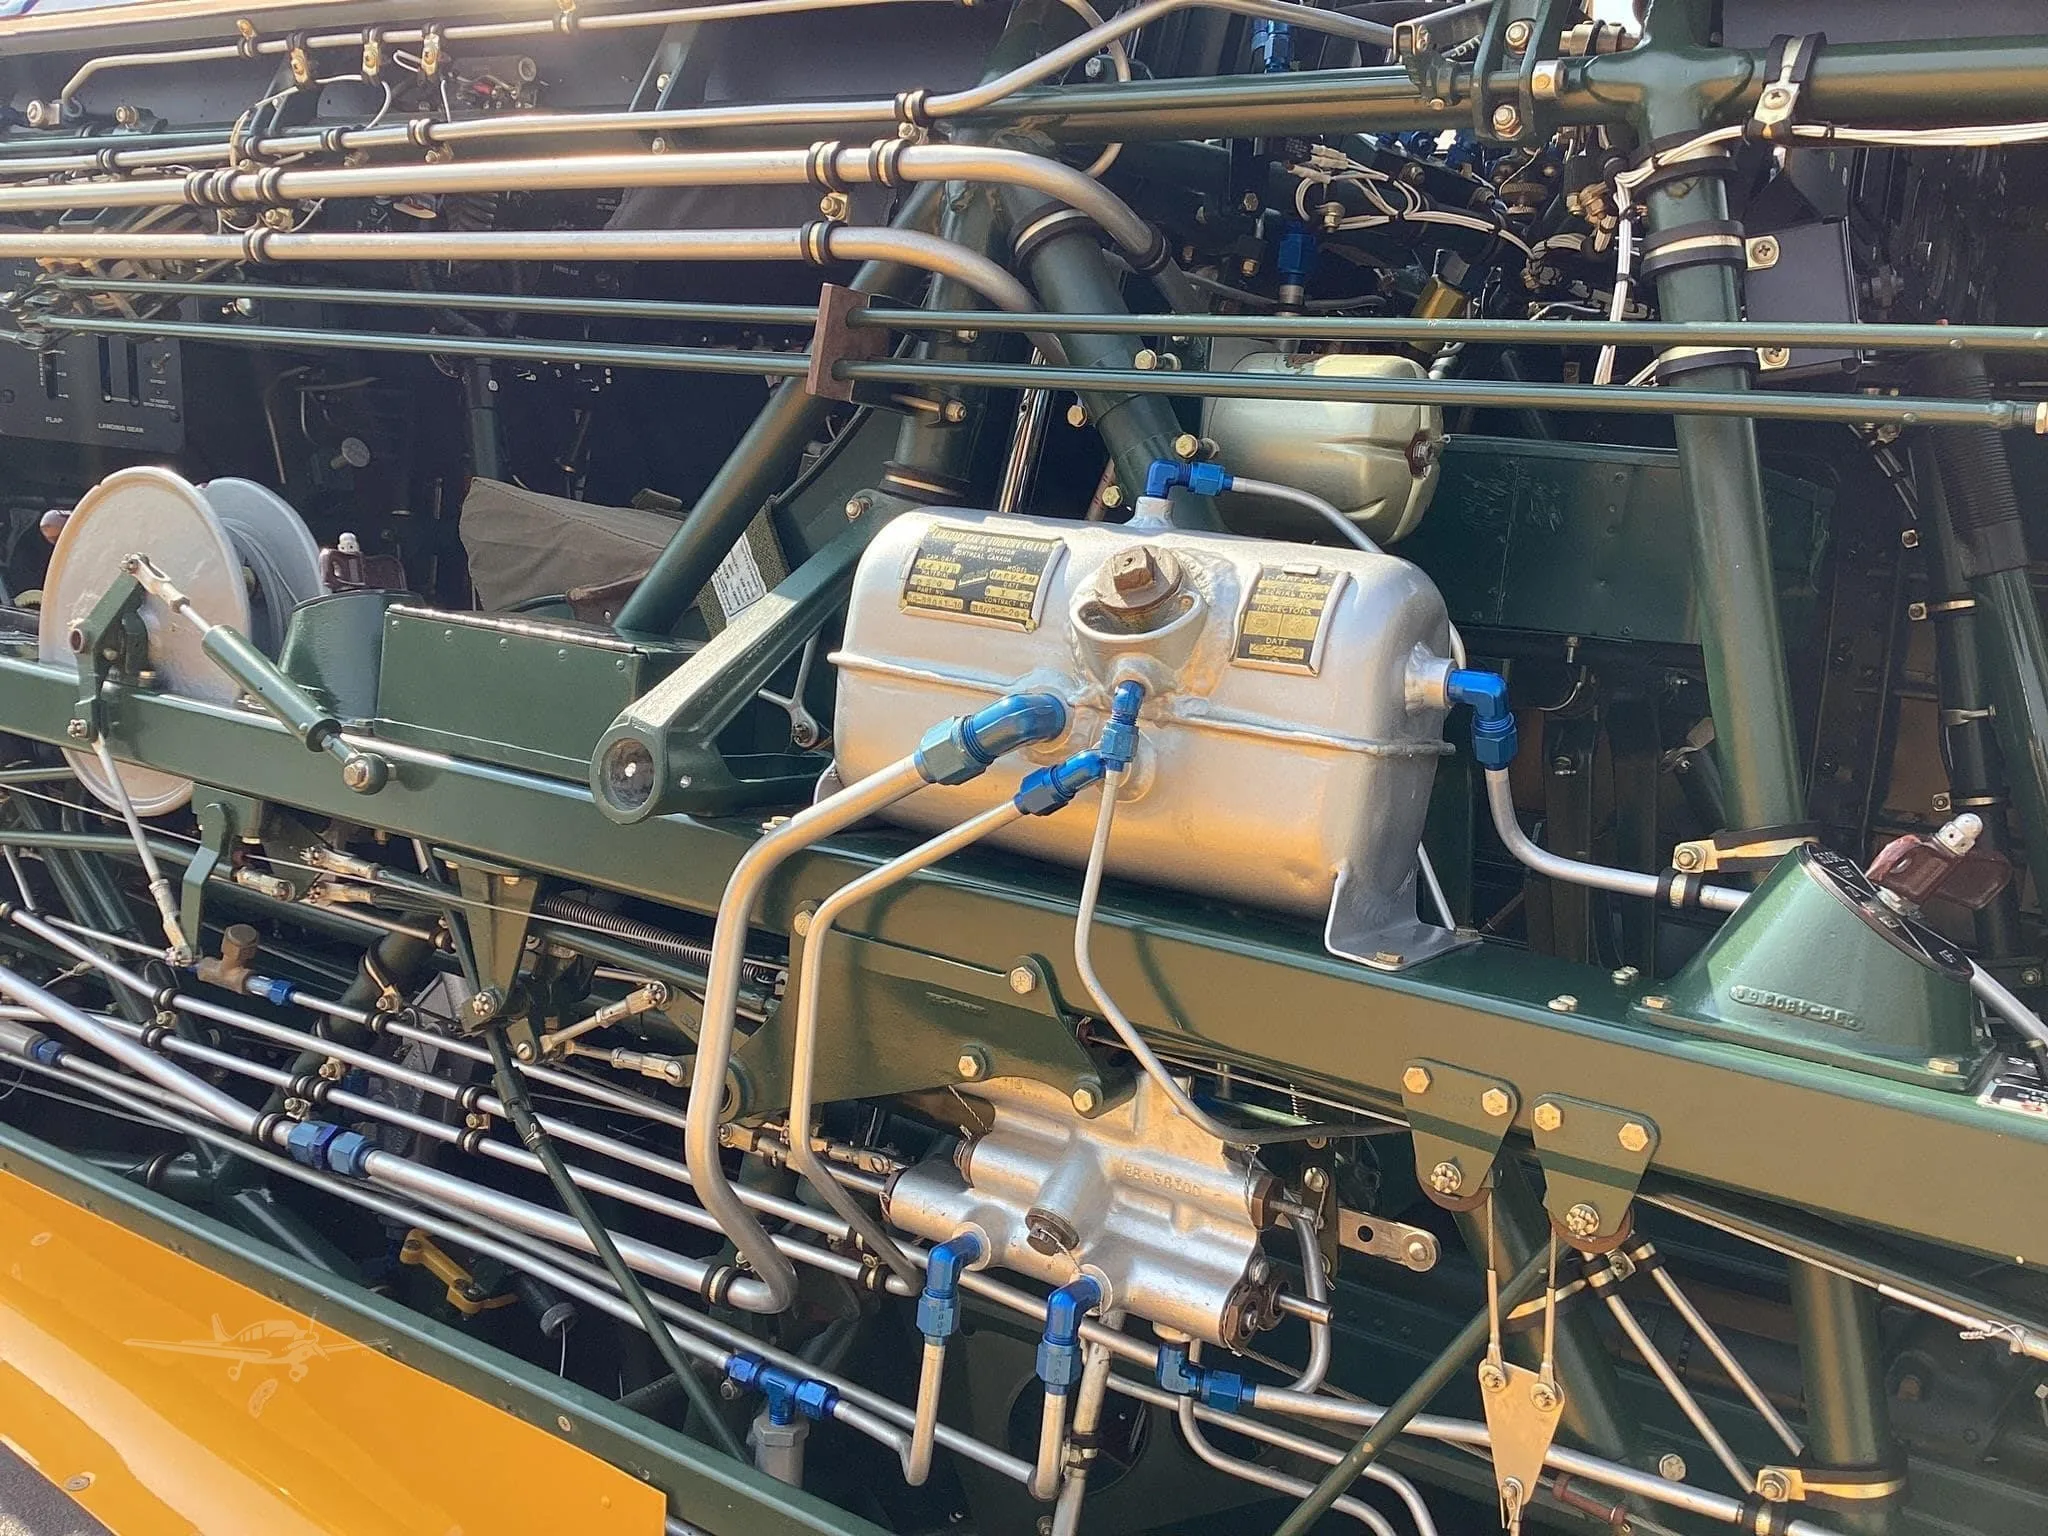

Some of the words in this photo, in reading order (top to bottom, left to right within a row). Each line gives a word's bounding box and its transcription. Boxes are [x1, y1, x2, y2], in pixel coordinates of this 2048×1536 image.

[45, 416, 63, 424] FLAP
[98, 423, 126, 432] LANDING
[966, 533, 980, 544] CAR
[985, 546, 1016, 555] DIVISION
[986, 554, 1012, 563] CANADA
[1007, 565, 1027, 573] MODEL
[1276, 574, 1299, 582] PART
[1003, 581, 1020, 589] DATE
[1265, 588, 1296, 597] SERIAL
[984, 597, 1018, 606] CONTRACT
[1257, 604, 1312, 615] INSPECTORS
[1265, 637, 1289, 646] DATE
